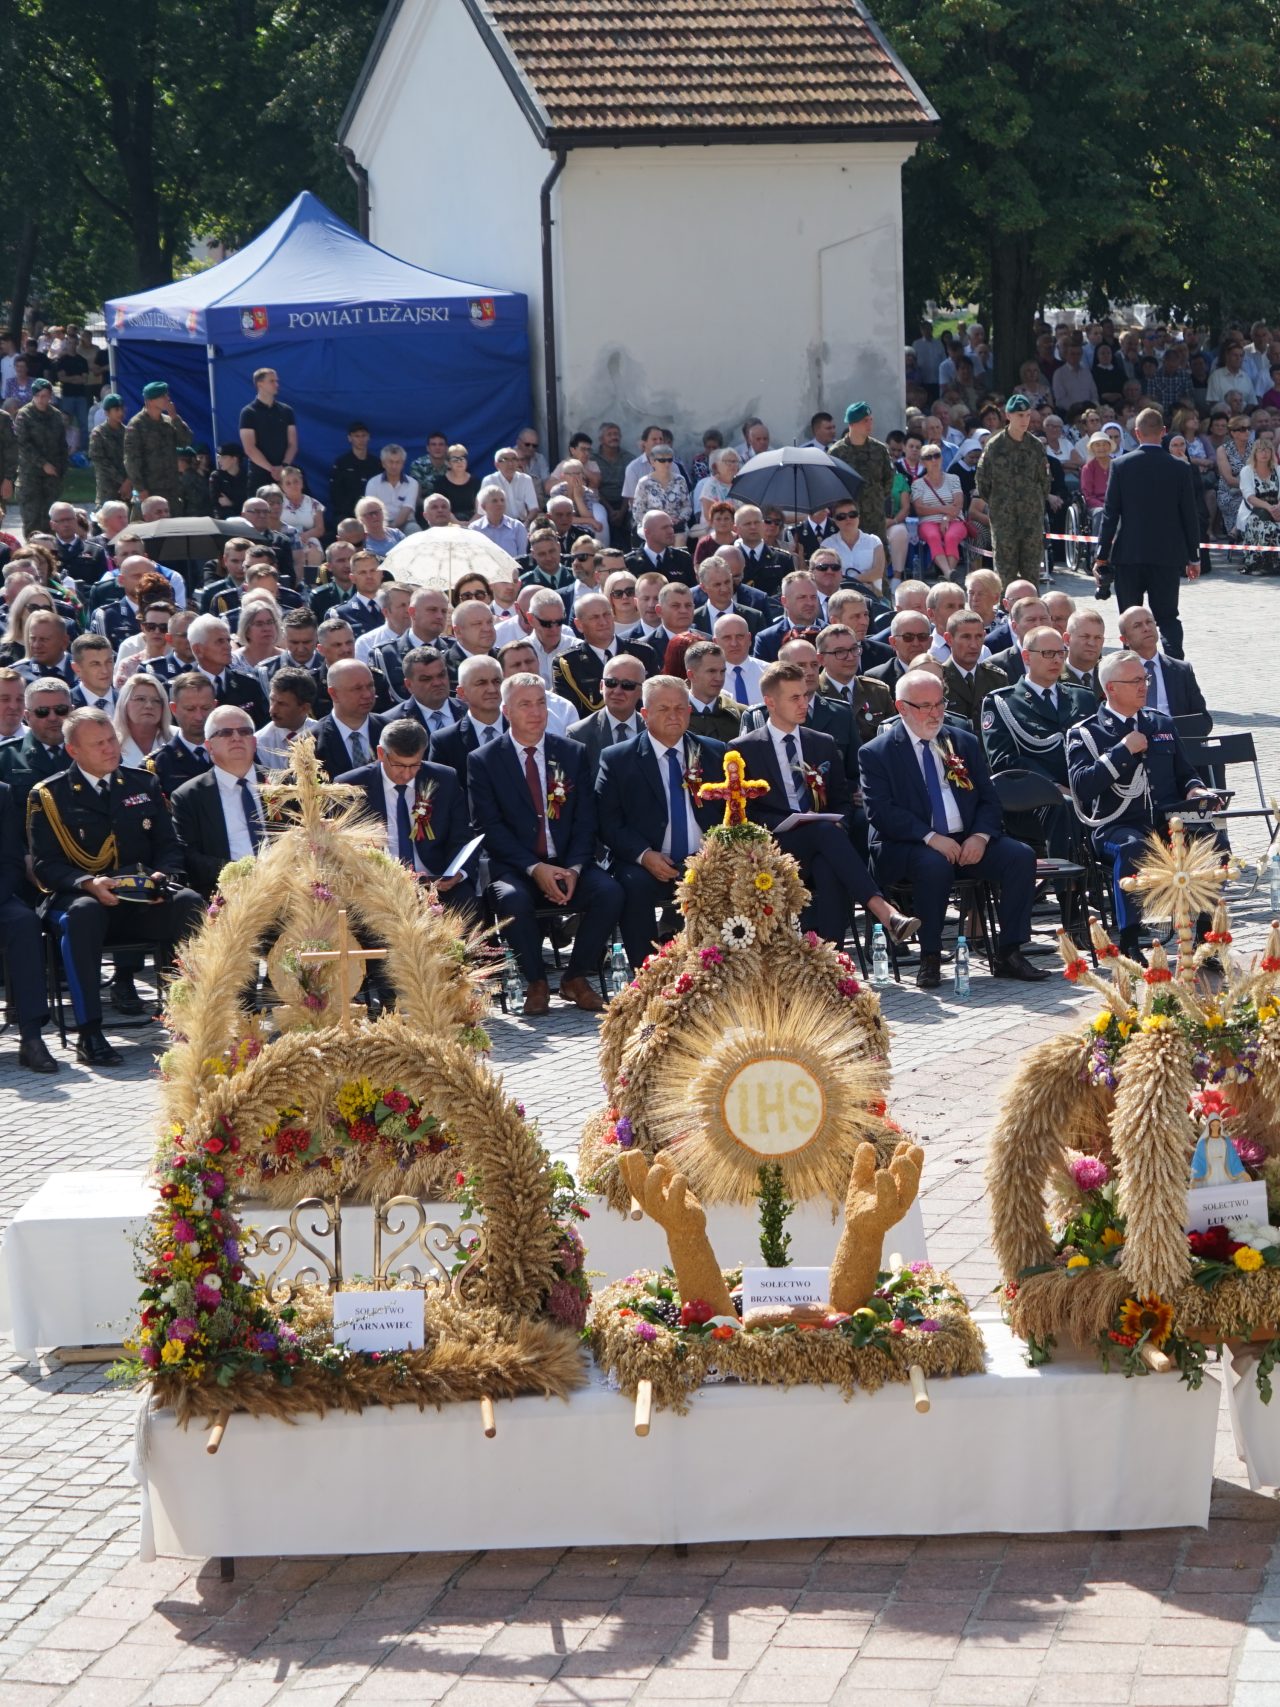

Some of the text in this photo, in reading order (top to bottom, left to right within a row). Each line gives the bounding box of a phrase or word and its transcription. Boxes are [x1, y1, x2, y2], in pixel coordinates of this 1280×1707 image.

[288, 304, 450, 328] POWIAT LEŻAJSKI
[738, 1080, 819, 1133] IHS
[750, 1295, 792, 1303] BRZYSKA
[352, 1321, 413, 1331] TARNAWIEC
